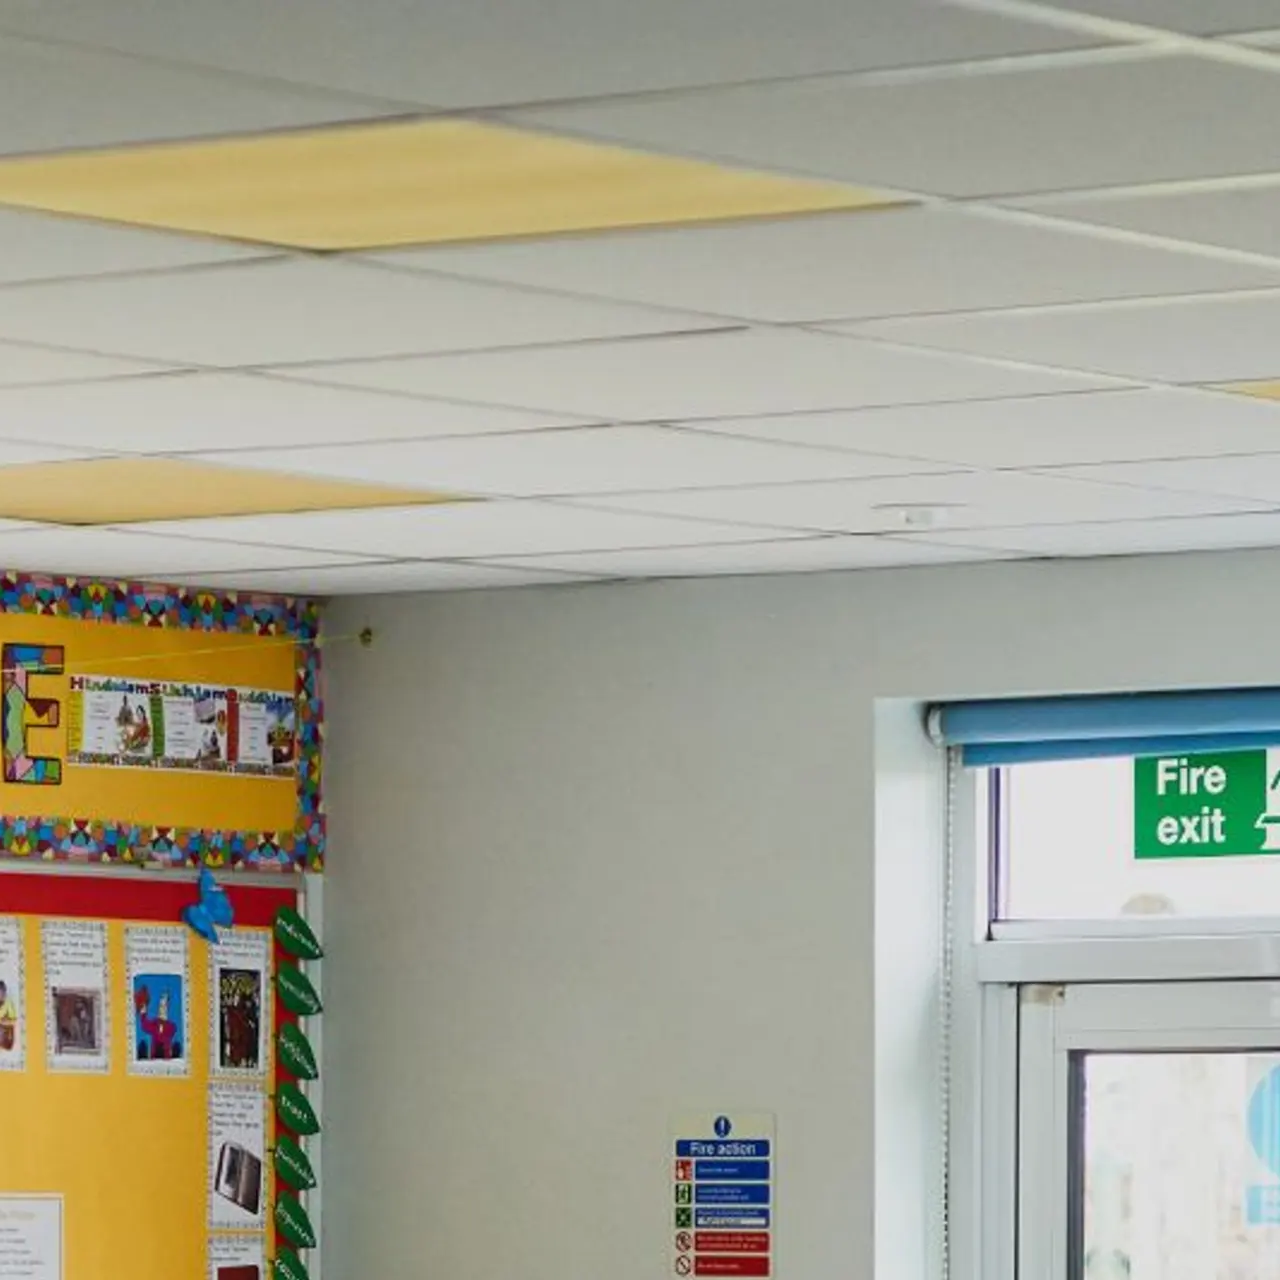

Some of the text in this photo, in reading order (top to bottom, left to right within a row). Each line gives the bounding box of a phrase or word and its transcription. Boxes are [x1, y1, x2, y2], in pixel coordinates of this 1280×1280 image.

[1157, 758, 1227, 795] Fire
[1156, 806, 1227, 845] exit
[690, 1142, 756, 1155] Fire action
